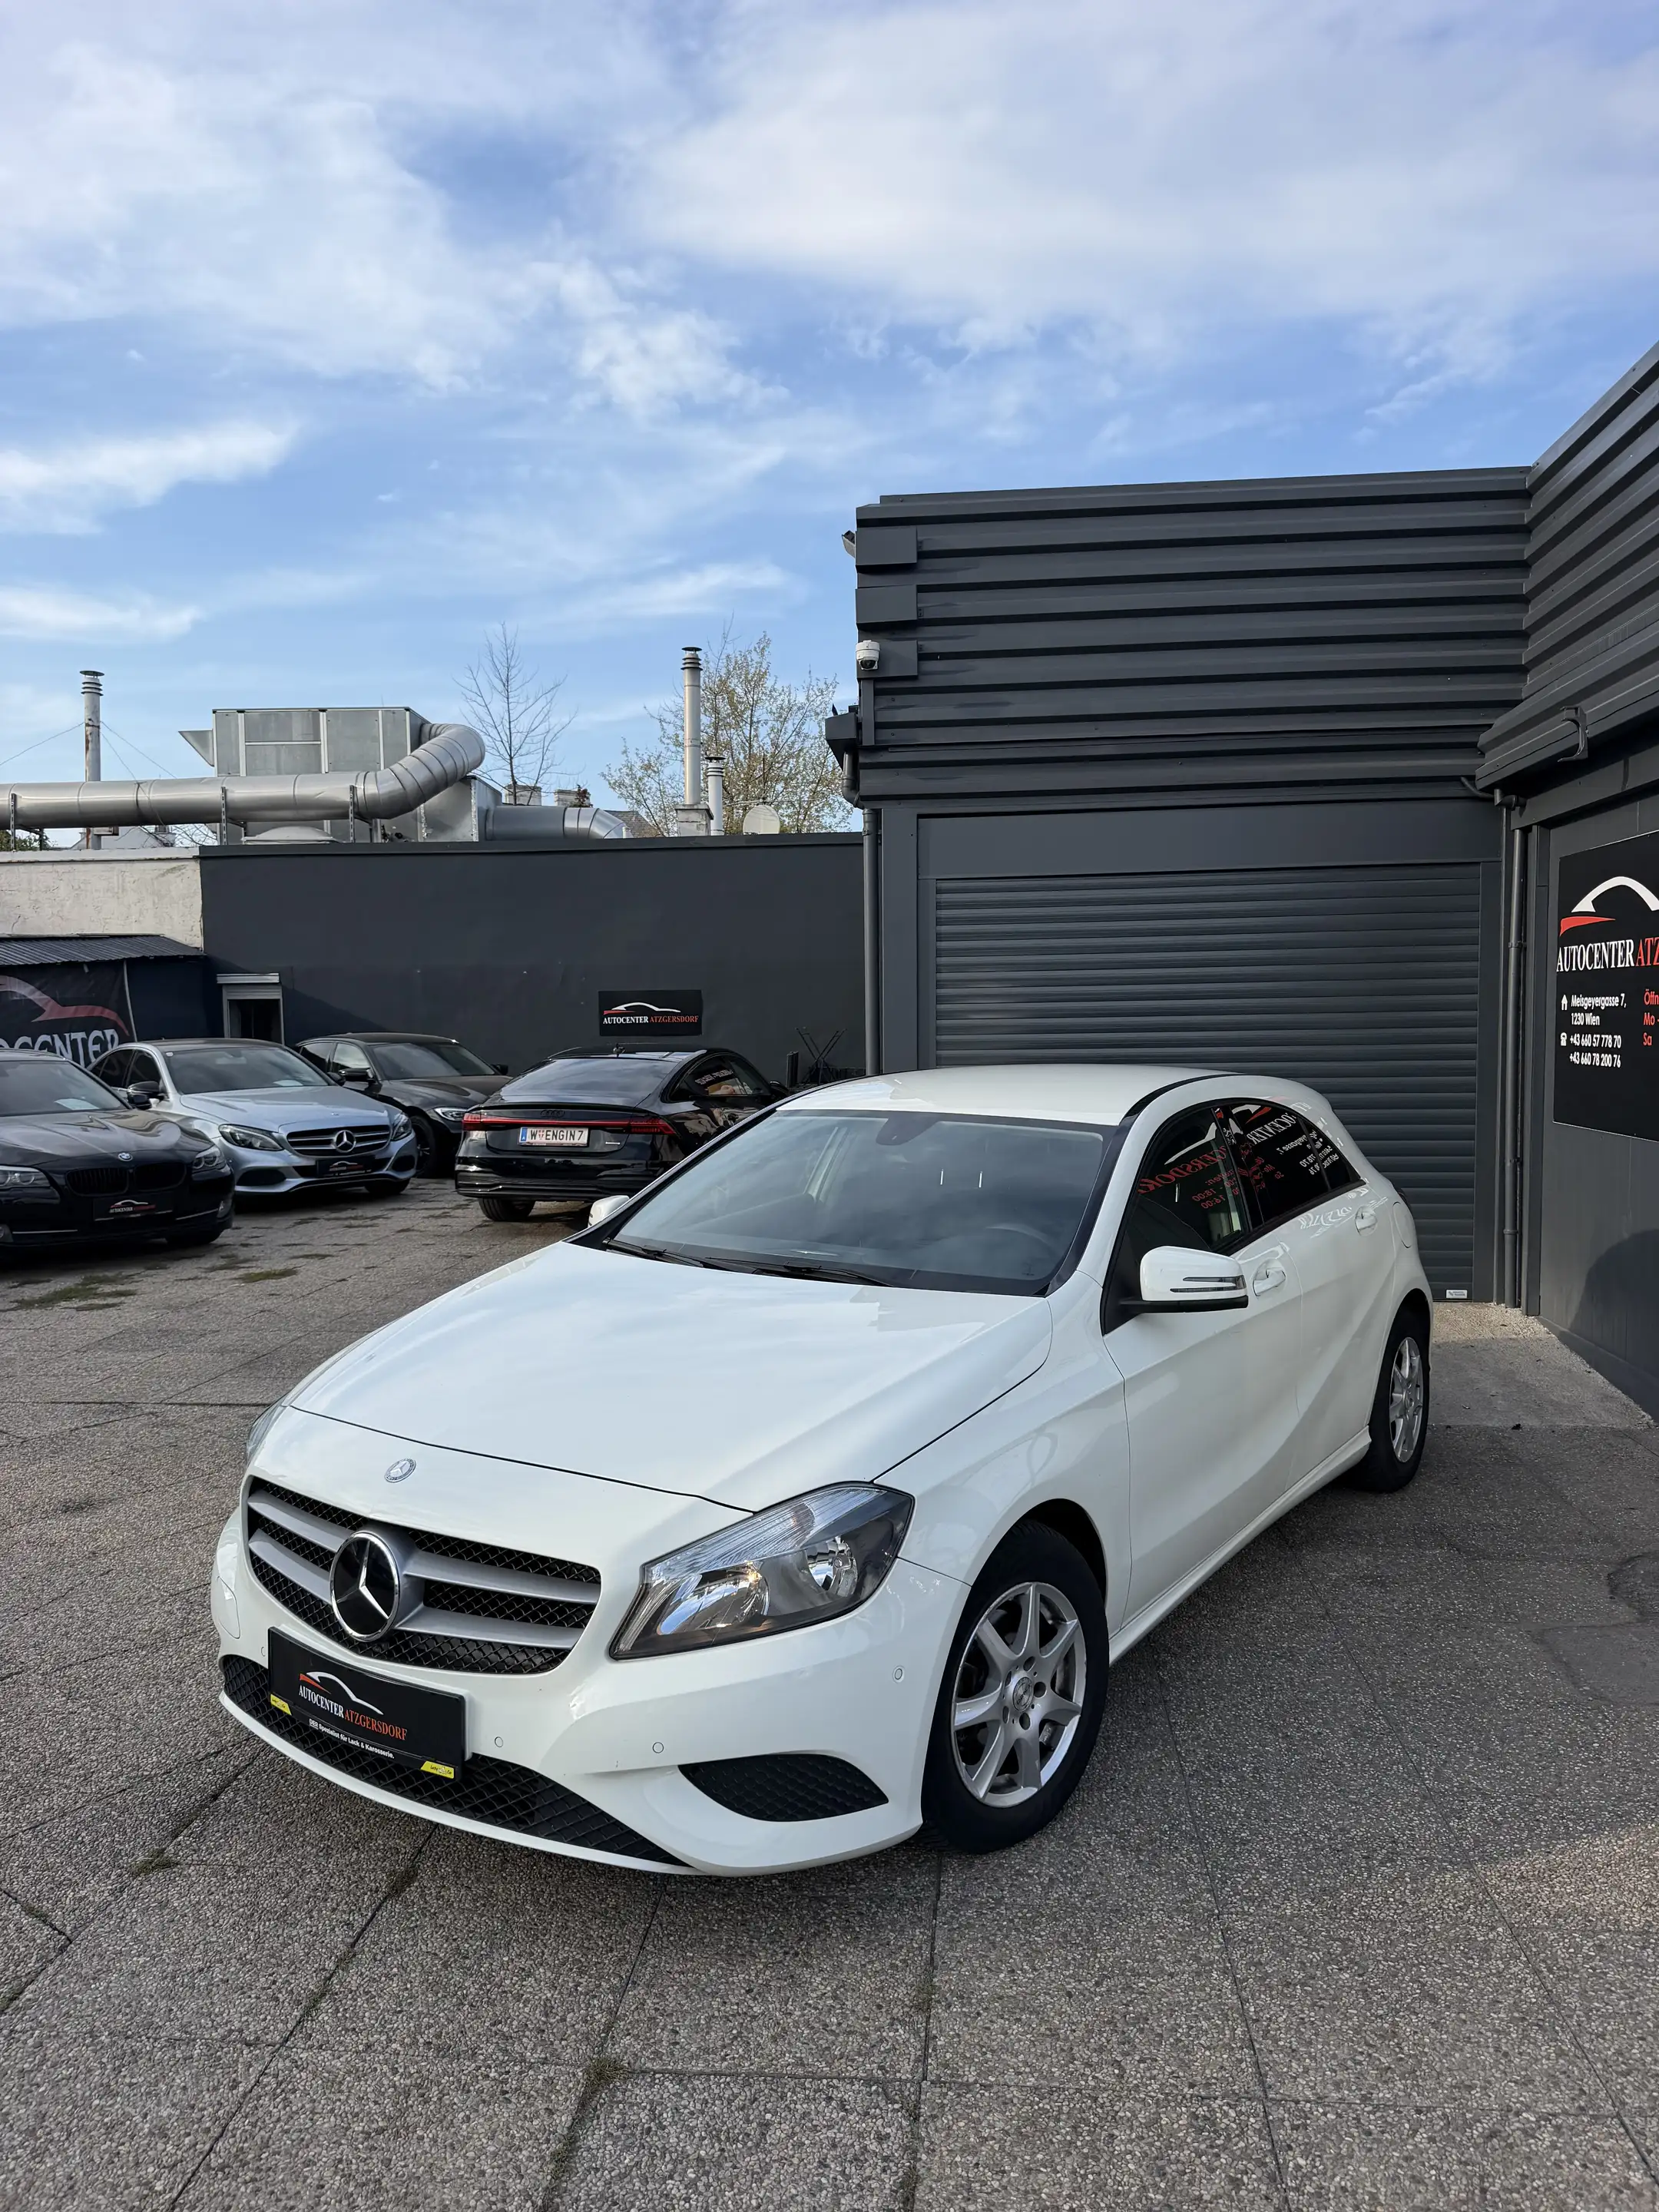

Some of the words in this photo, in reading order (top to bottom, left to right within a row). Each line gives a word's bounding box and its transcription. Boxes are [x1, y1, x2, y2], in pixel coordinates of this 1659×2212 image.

[1556, 939, 1635, 972] AUTOCENTER
[1620, 993, 1627, 1008] 7,
[603, 1015, 649, 1025] AUTOCENTER
[1571, 1012, 1584, 1025] 1230
[1585, 1012, 1600, 1026] Wien
[1643, 1012, 1655, 1026] Mo
[1569, 1033, 1581, 1047] +43
[1581, 1034, 1591, 1047] 660
[1592, 1034, 1600, 1048] 57
[1601, 1035, 1613, 1048] 778
[1613, 1035, 1621, 1048] 70
[1643, 1032, 1652, 1046] Sa
[1569, 1051, 1580, 1065] +43
[1581, 1052, 1591, 1065] 660
[1592, 1053, 1600, 1066] 78
[1601, 1053, 1612, 1068] 200
[1613, 1054, 1621, 1068] 76
[530, 1130, 538, 1140] W
[298, 1684, 344, 1719] AUTOCENTER
[345, 1709, 407, 1741] ATZGERSDORF
[309, 1718, 319, 1730] DER
[318, 1723, 339, 1739] Spezialist
[348, 1737, 360, 1747] Lack
[365, 1743, 395, 1759] Karosserie.
